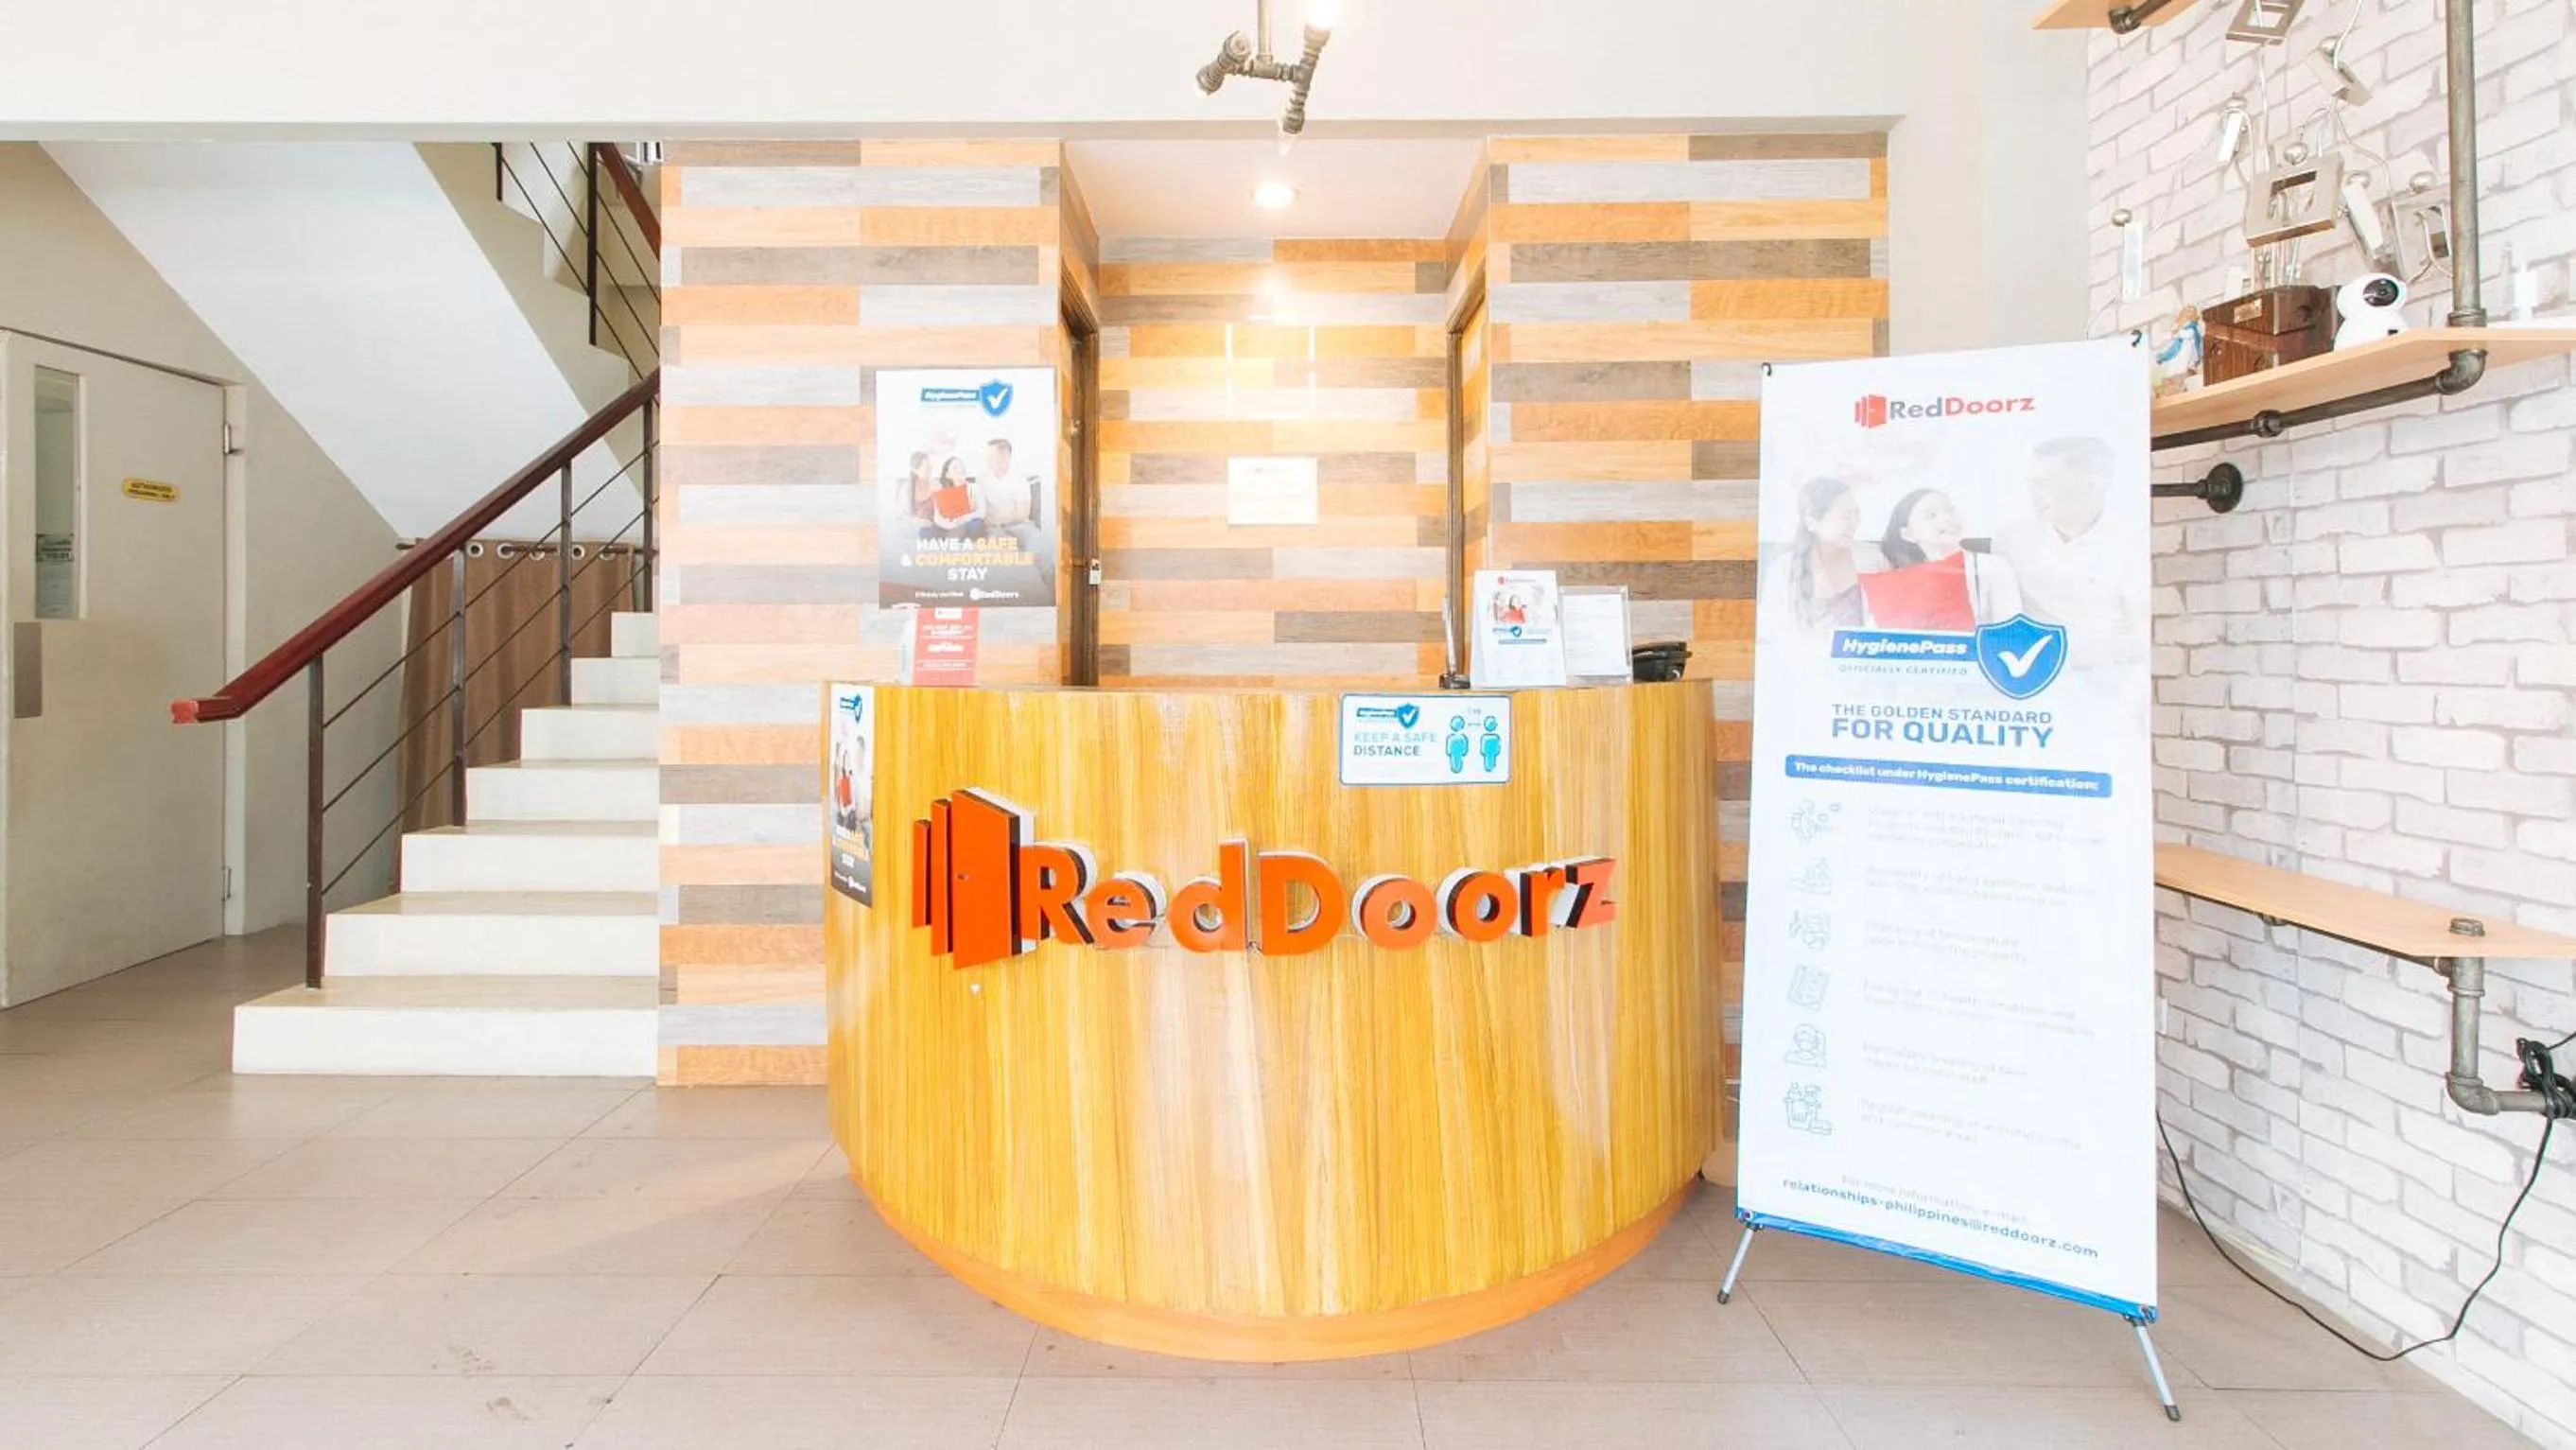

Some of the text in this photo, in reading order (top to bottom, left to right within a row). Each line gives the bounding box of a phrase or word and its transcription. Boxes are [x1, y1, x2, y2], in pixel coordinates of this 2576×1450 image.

[1889, 396, 2035, 419] RedDoorz
[916, 536, 1018, 551] HAVE A SAFE
[914, 551, 1035, 567] COMFORTABLE
[947, 567, 988, 581] STAY
[1841, 637, 1968, 656] HygienePass
[1832, 704, 2052, 725] THE GOLDEN STANDARD
[1354, 731, 1438, 743] KEEP A SAFE
[1832, 718, 2054, 748] FOR QUALITY
[1353, 744, 1421, 757] DISTANCE
[1794, 761, 1818, 773] The
[1819, 763, 1875, 777] checklist
[1876, 767, 1916, 778] under
[1916, 769, 2003, 784] HygienePass
[1018, 837, 1618, 956] RedDoorz
[1782, 1179, 2099, 1259] relationships-philippines@reddoorz.com
